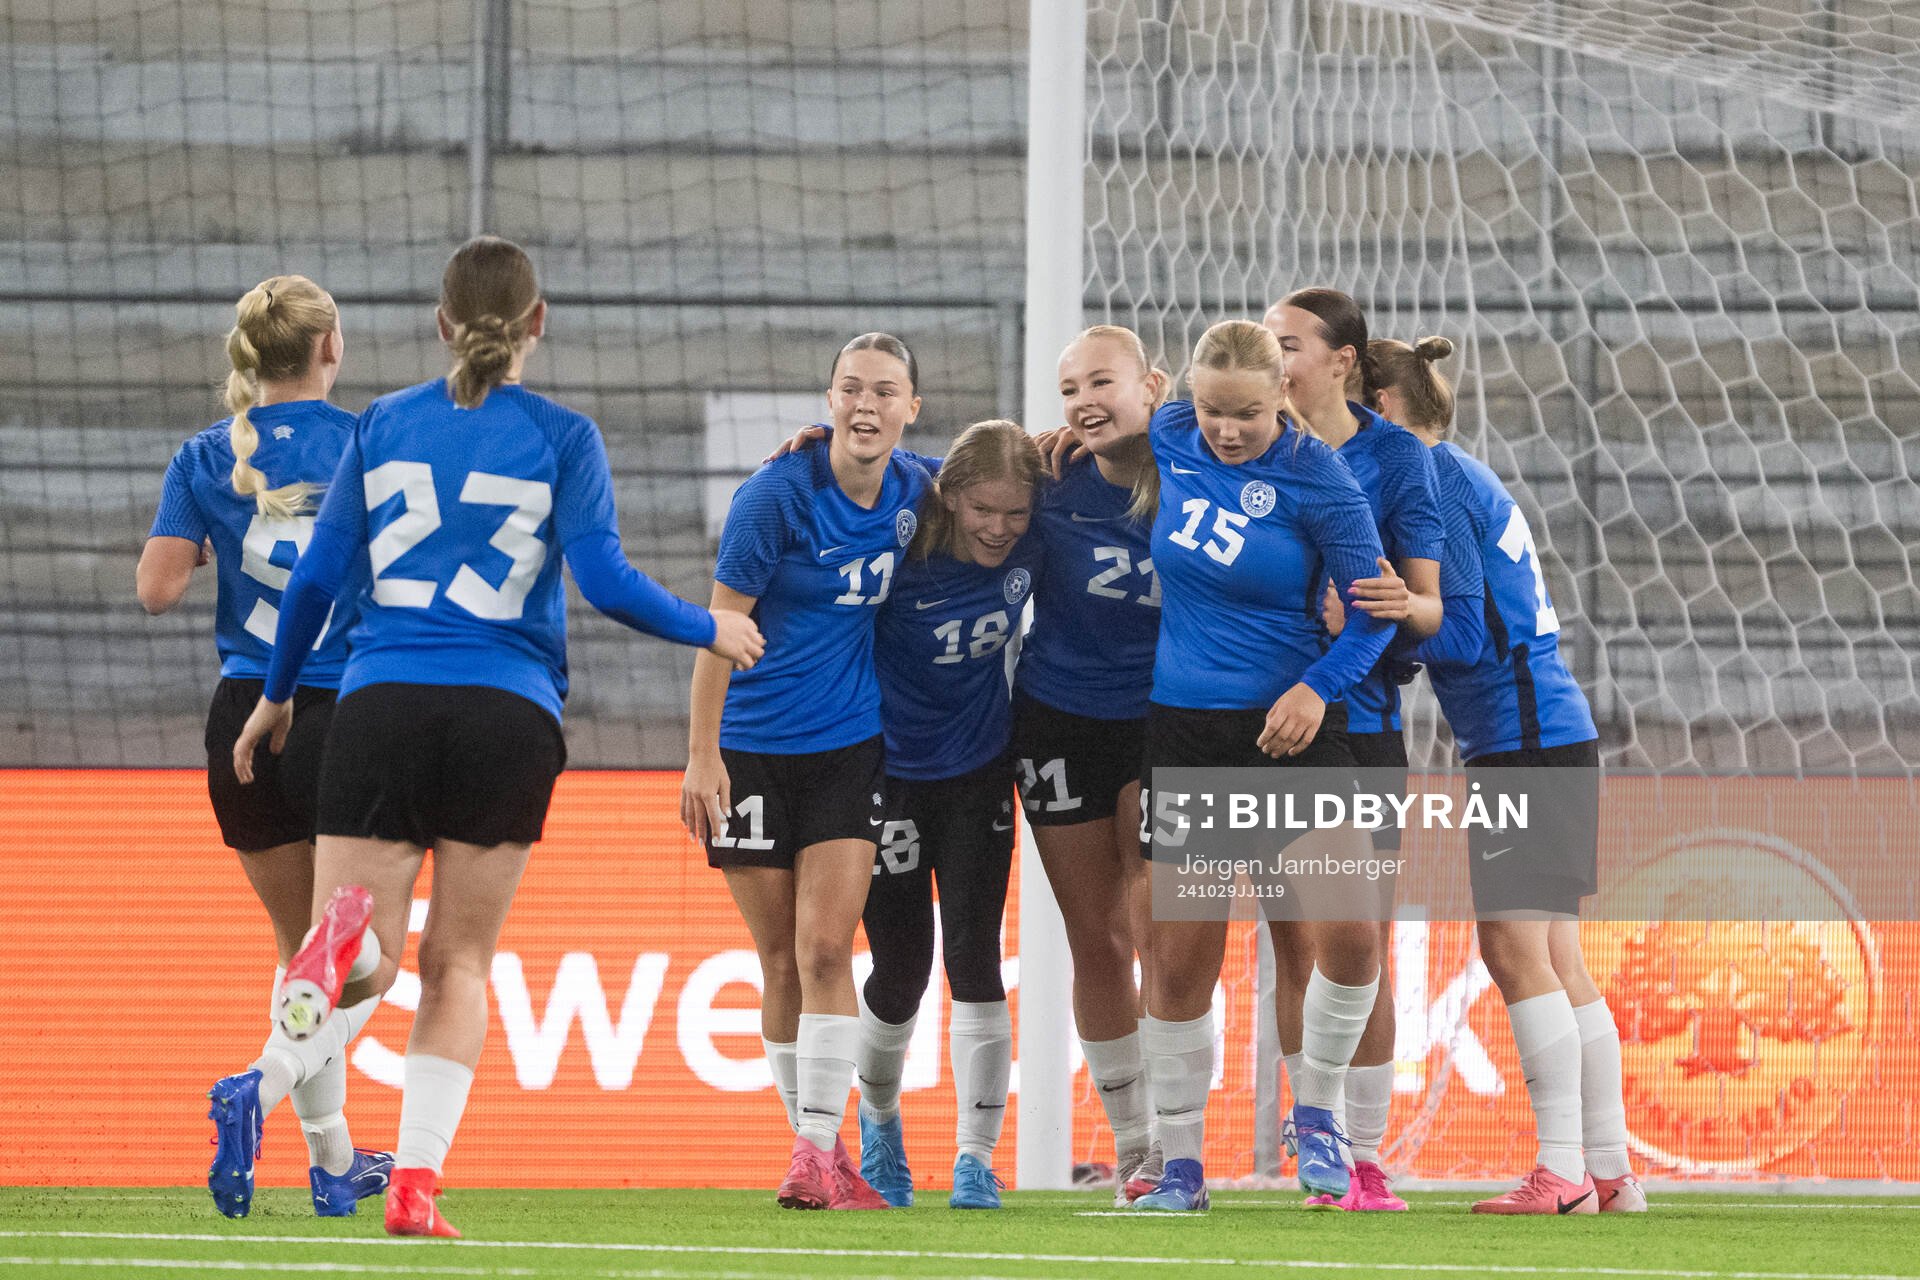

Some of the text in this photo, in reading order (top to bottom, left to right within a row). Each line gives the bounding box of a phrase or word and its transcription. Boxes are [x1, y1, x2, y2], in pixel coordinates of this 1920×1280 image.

[364, 460, 552, 620] 23
[1168, 498, 1250, 566] 15
[834, 552, 895, 606] 11
[1087, 546, 1162, 607] 21
[932, 610, 1010, 664] 18
[872, 819, 921, 874] 8
